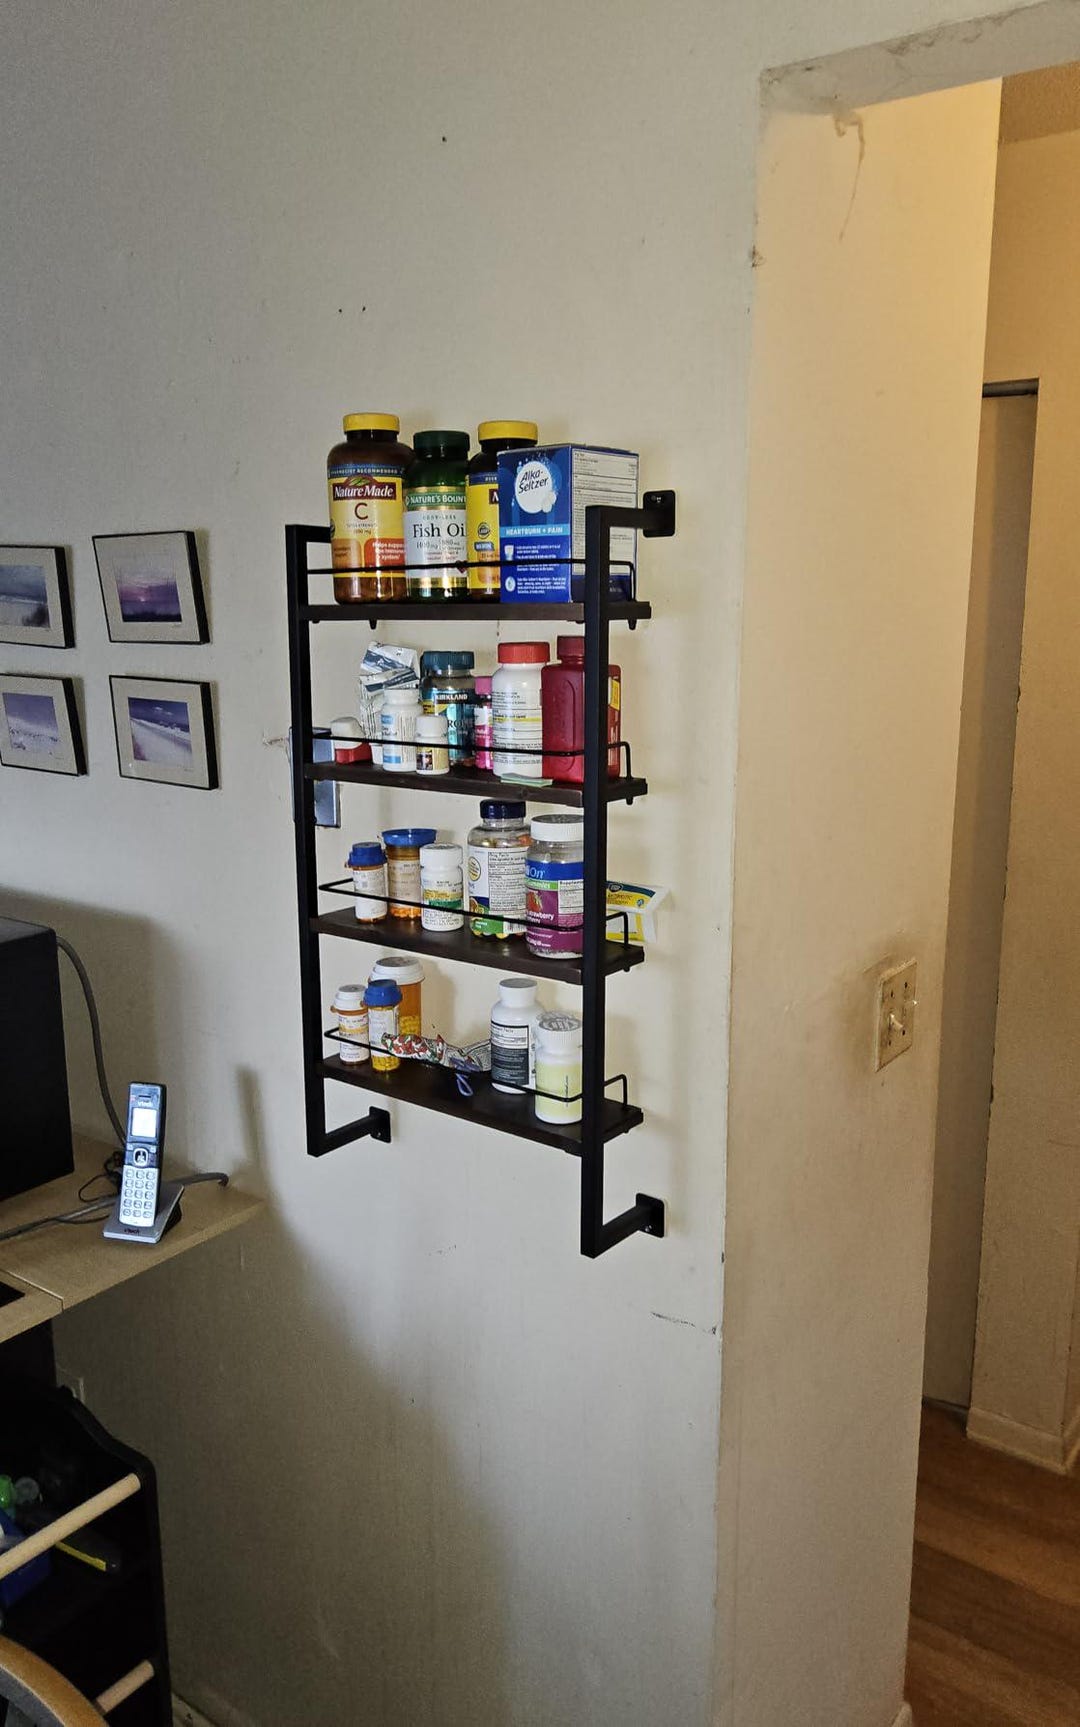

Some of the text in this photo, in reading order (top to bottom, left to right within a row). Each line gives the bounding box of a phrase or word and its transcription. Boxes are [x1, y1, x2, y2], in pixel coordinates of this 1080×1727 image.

[522, 470, 544, 482] Alka-
[518, 477, 549, 494] Seltzer
[410, 494, 466, 504] NATURE'S BOUN
[354, 502, 368, 520] C
[413, 523, 441, 538] Fish
[447, 523, 467, 538] Oi
[506, 528, 540, 536] HEARTBURN
